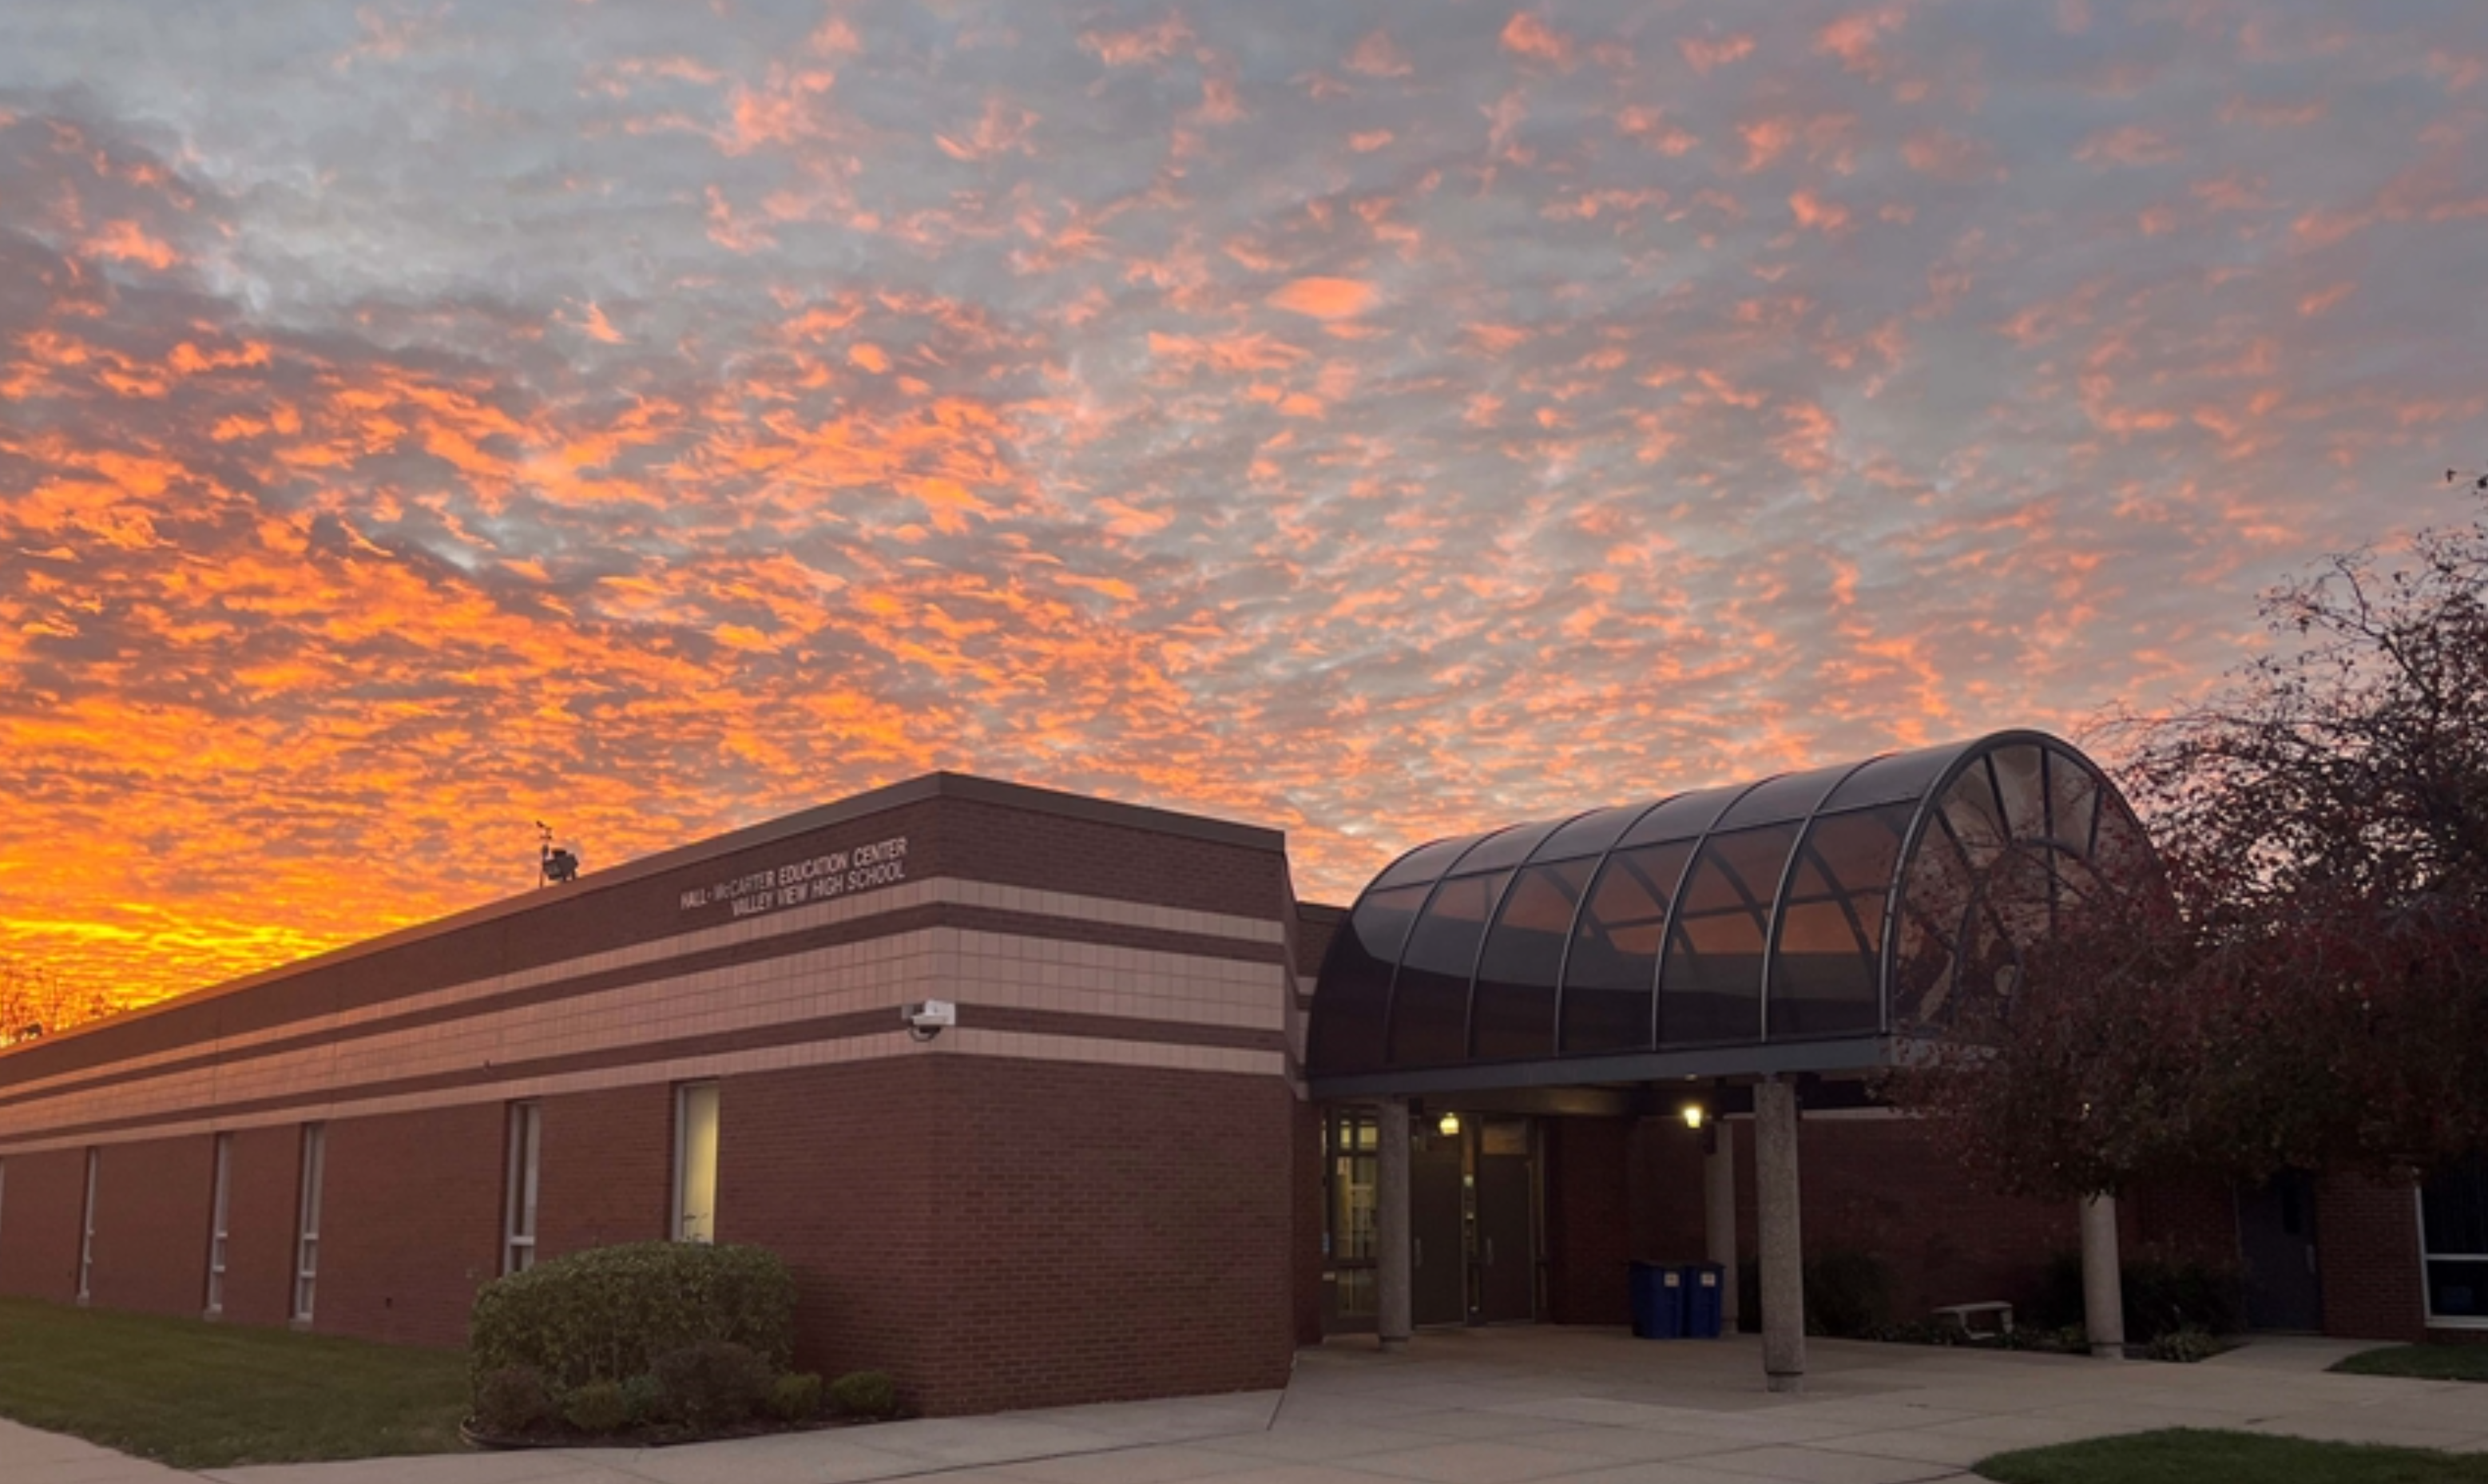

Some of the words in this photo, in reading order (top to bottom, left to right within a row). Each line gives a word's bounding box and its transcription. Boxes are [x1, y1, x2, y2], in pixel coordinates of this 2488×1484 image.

[731, 892, 773, 916] VALLEY
[777, 883, 808, 906] VIEW
[811, 875, 843, 899] HIGH
[848, 859, 905, 891] SCHOOL
[778, 852, 848, 886] EDUCATION
[854, 837, 907, 867] CENTER
